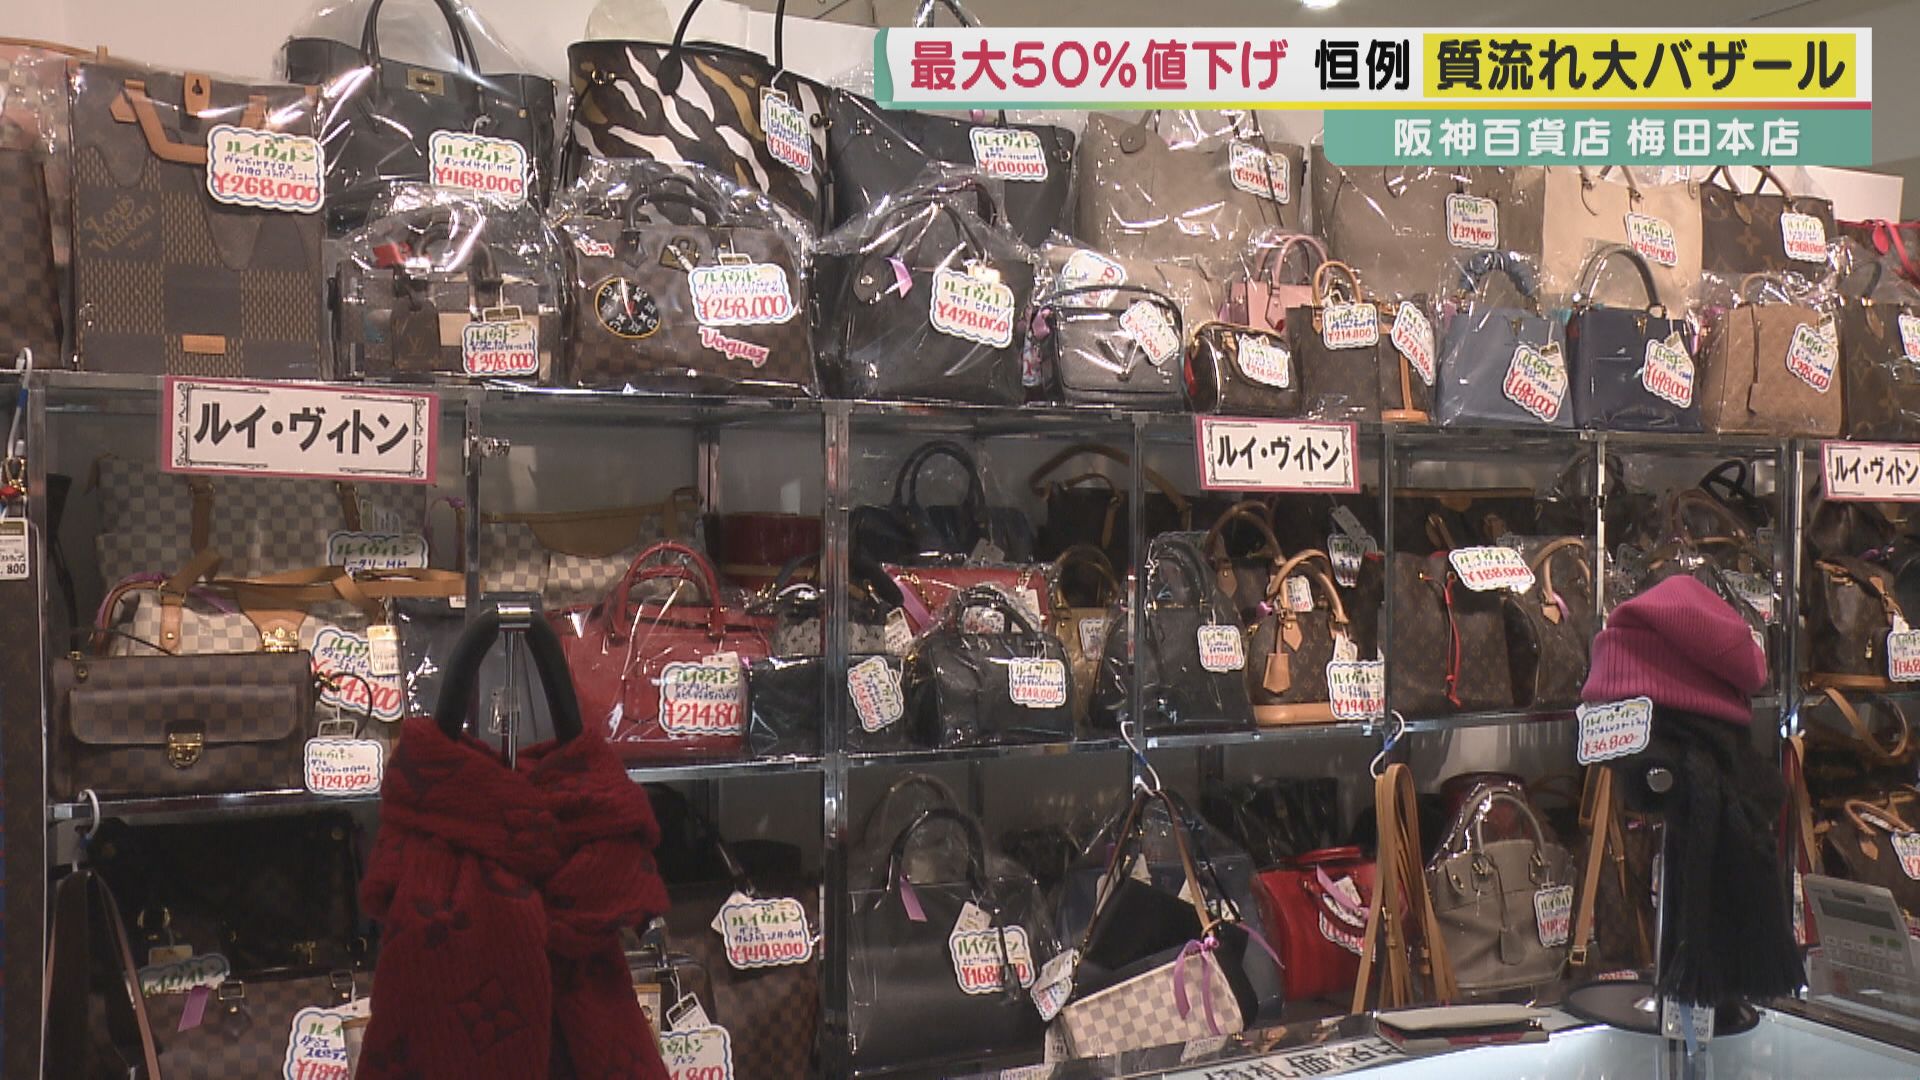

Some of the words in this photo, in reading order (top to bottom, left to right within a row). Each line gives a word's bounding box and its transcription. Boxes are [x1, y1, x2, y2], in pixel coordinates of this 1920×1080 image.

[225, 137, 314, 162] ルイヴィトン
[441, 142, 516, 163] ルイヴィトン
[194, 401, 409, 454] ルイ・ヴィトン
[1217, 435, 1340, 471] ルイ・ヴィトン
[1835, 455, 1918, 486] ルイ・ヴィトン
